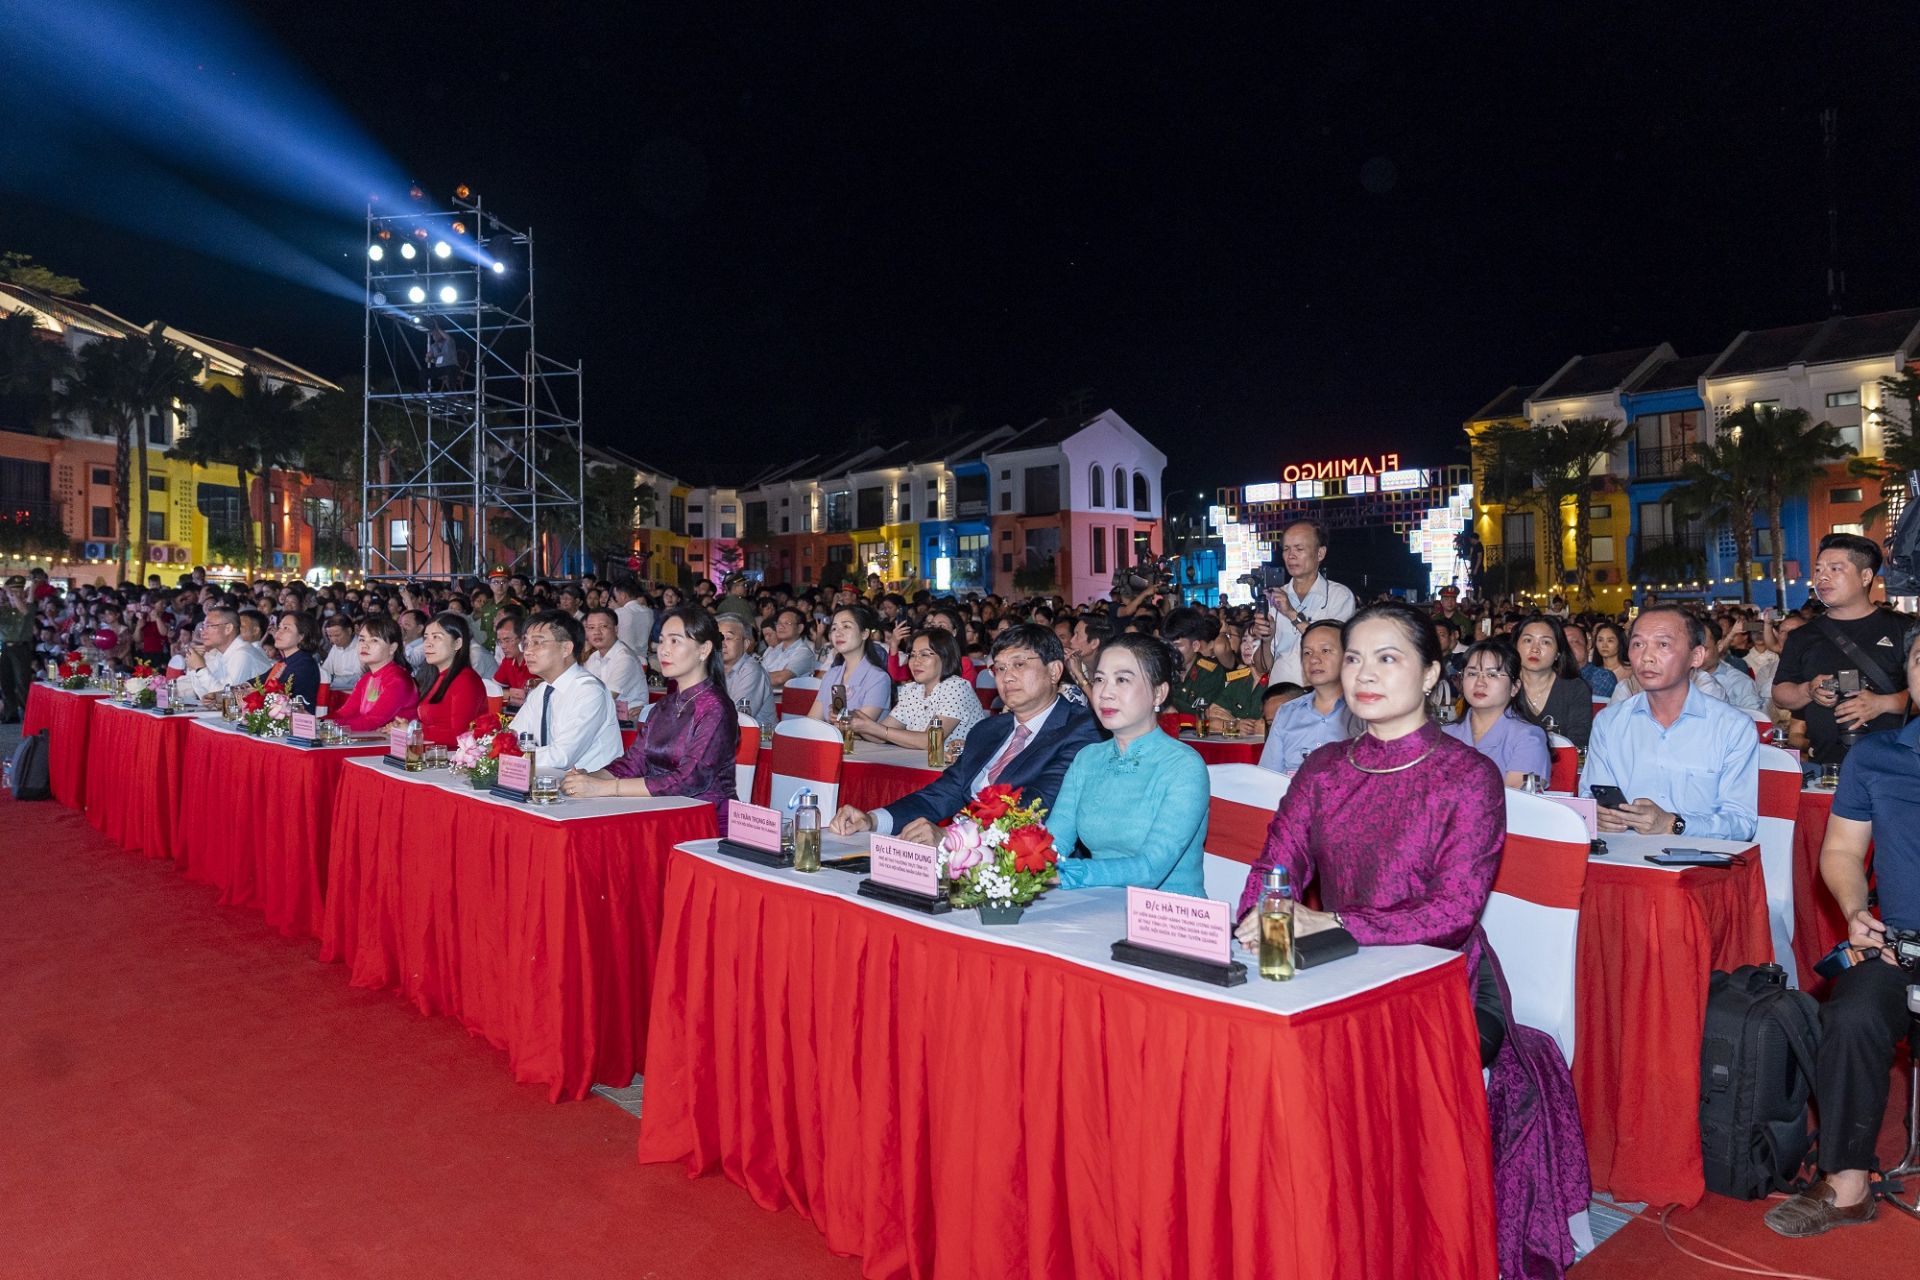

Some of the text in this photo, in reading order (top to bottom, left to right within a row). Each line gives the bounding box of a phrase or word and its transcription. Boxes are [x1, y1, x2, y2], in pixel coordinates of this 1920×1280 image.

[875, 844, 885, 854] Đ/c
[902, 851, 913, 860] KIM
[915, 853, 932, 864] DUNG
[1146, 900, 1210, 919] Đ/c HÀ THỊ NGA
